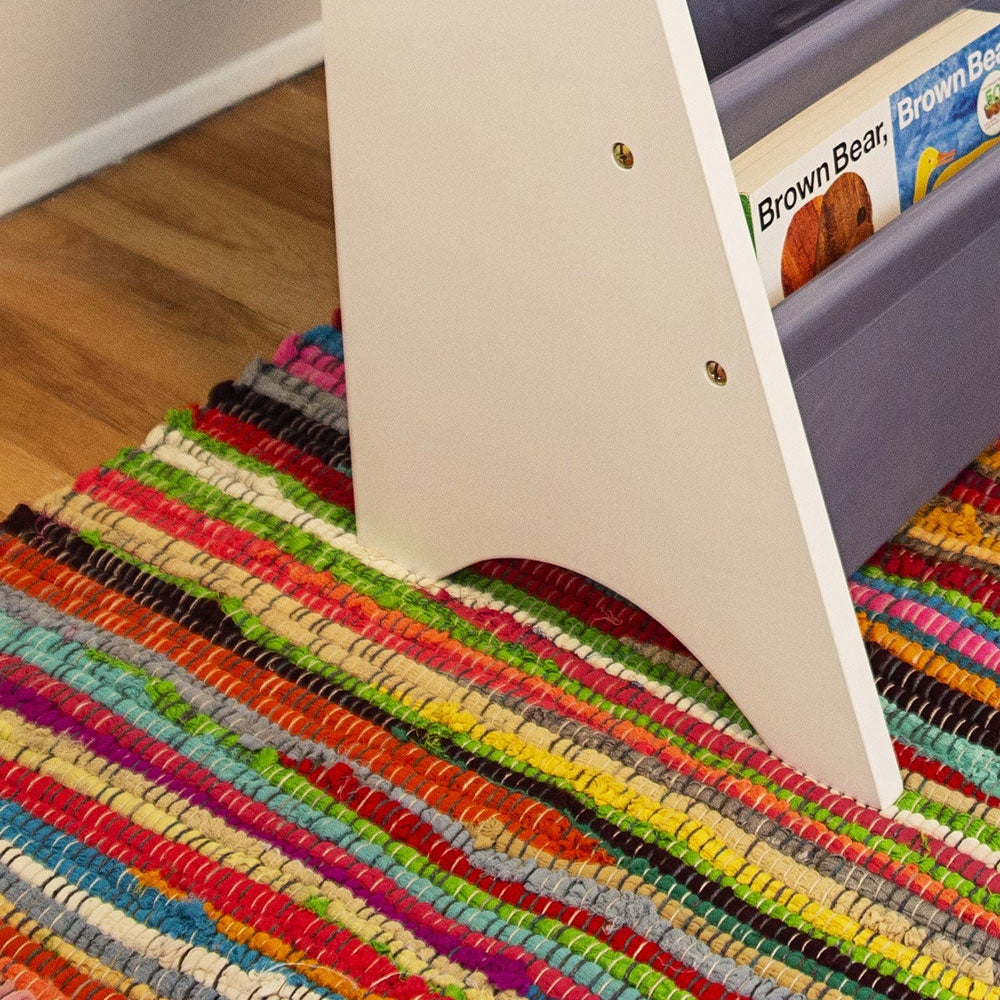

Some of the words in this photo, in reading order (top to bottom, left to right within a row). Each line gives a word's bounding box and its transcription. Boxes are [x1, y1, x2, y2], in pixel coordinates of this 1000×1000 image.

[757, 162, 831, 233] Brown
[832, 121, 889, 175] Bear,
[896, 68, 967, 130] Brown
